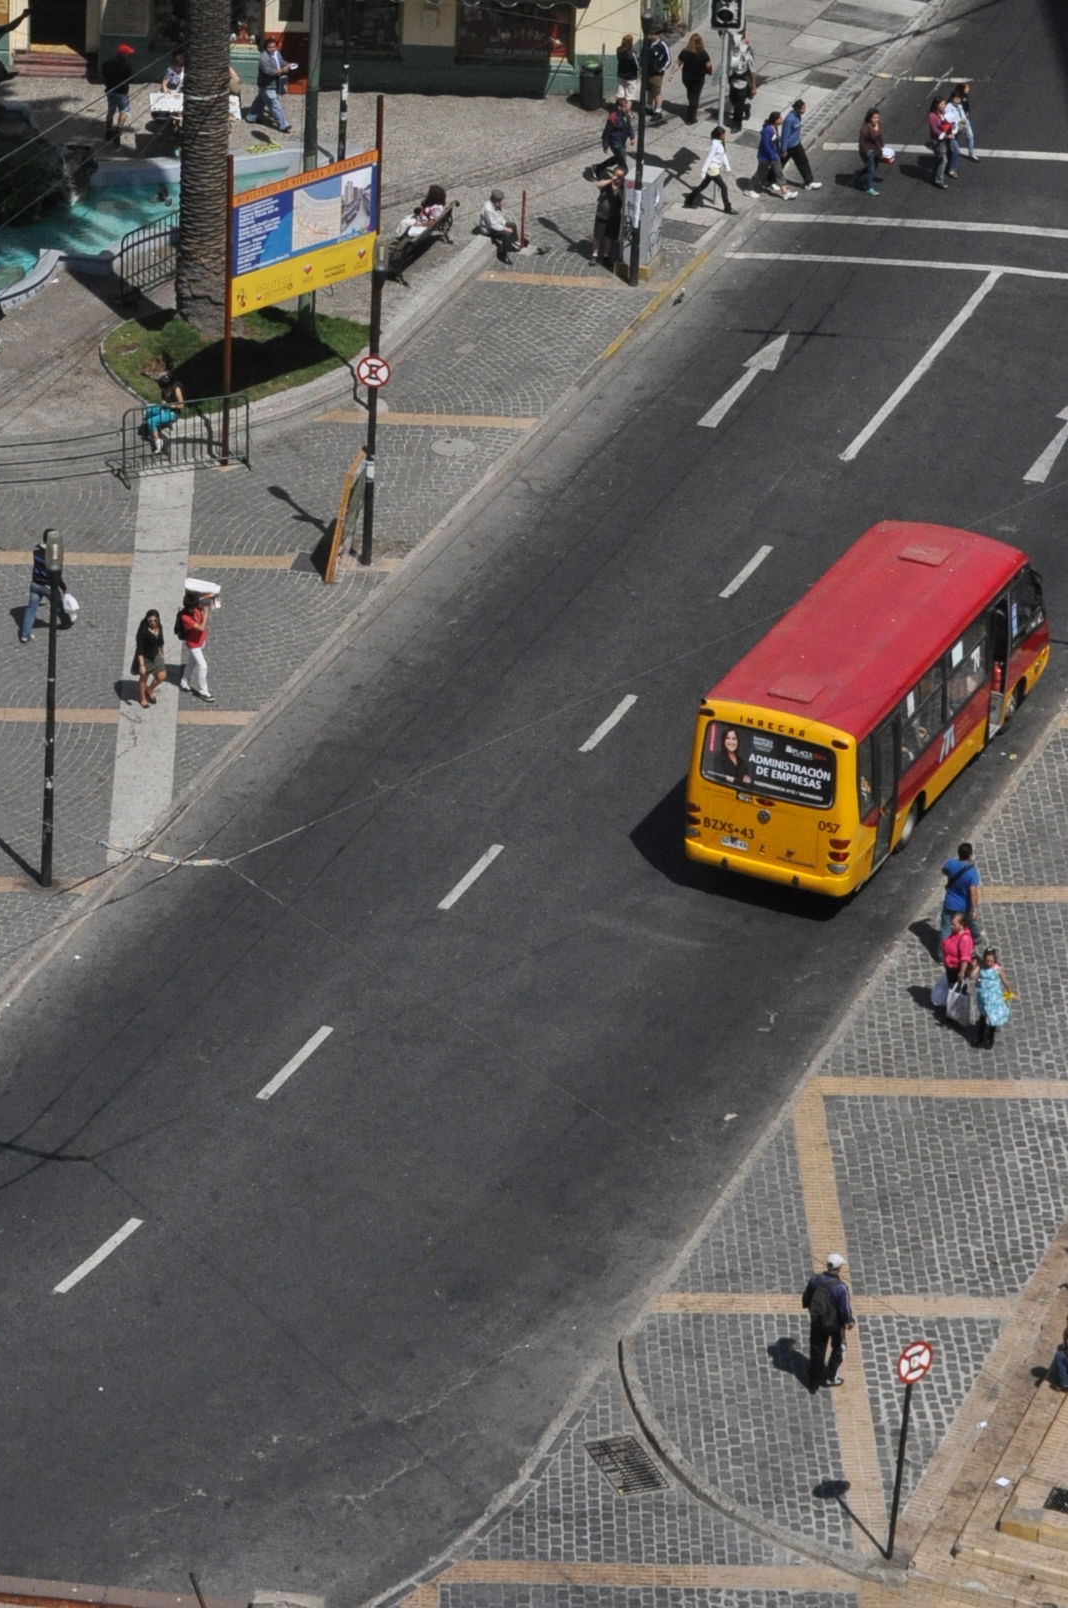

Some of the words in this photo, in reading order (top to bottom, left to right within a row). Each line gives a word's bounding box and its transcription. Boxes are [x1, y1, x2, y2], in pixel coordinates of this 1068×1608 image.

[748, 753, 832, 782] ADMINISTRACIÓN
[755, 766, 769, 778] DE
[771, 770, 822, 790] EMPRESAS
[818, 820, 840, 834] 057
